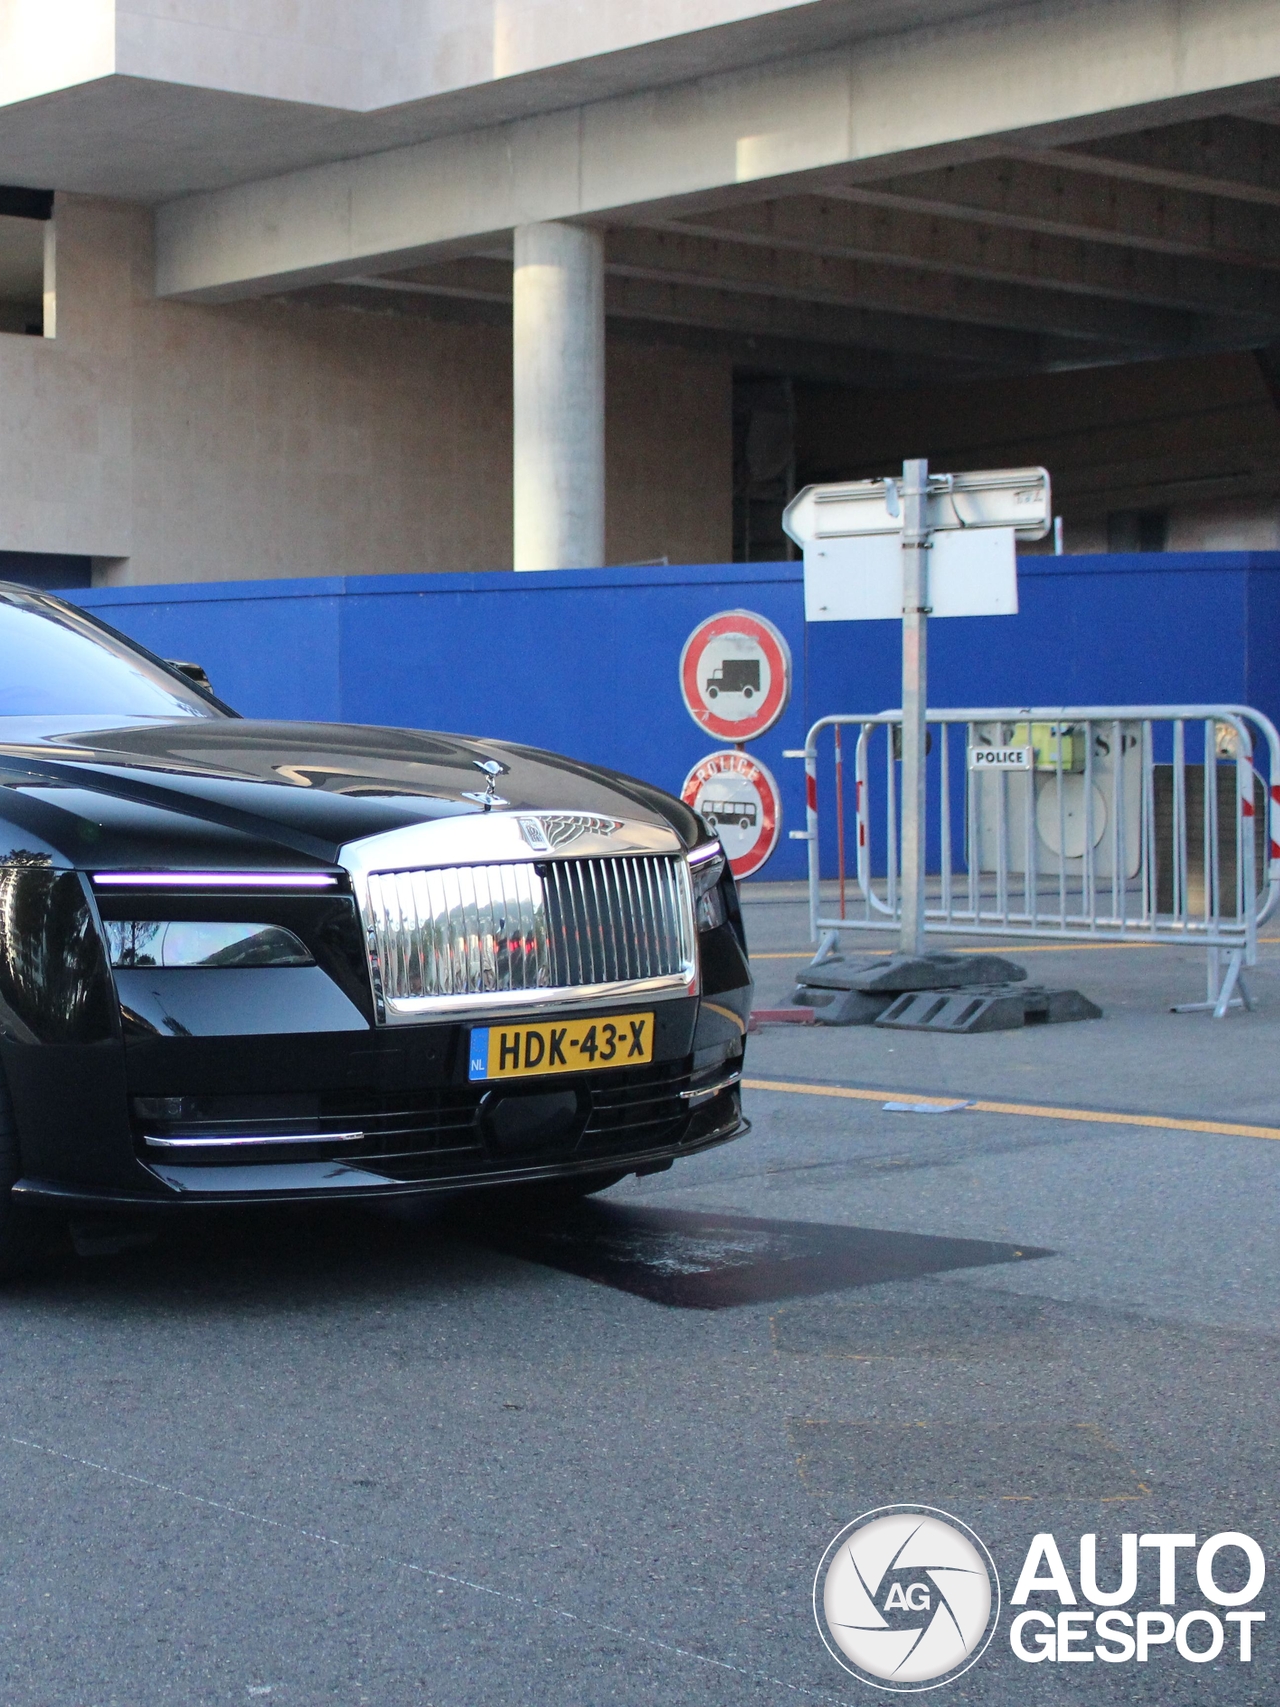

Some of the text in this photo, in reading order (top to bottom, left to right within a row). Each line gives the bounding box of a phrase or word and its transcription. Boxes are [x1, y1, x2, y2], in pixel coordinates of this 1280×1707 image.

[975, 751, 1023, 764] POLICE
[696, 756, 760, 785] POLICE
[499, 1020, 646, 1071] HDK-43-X
[471, 1059, 485, 1071] NL
